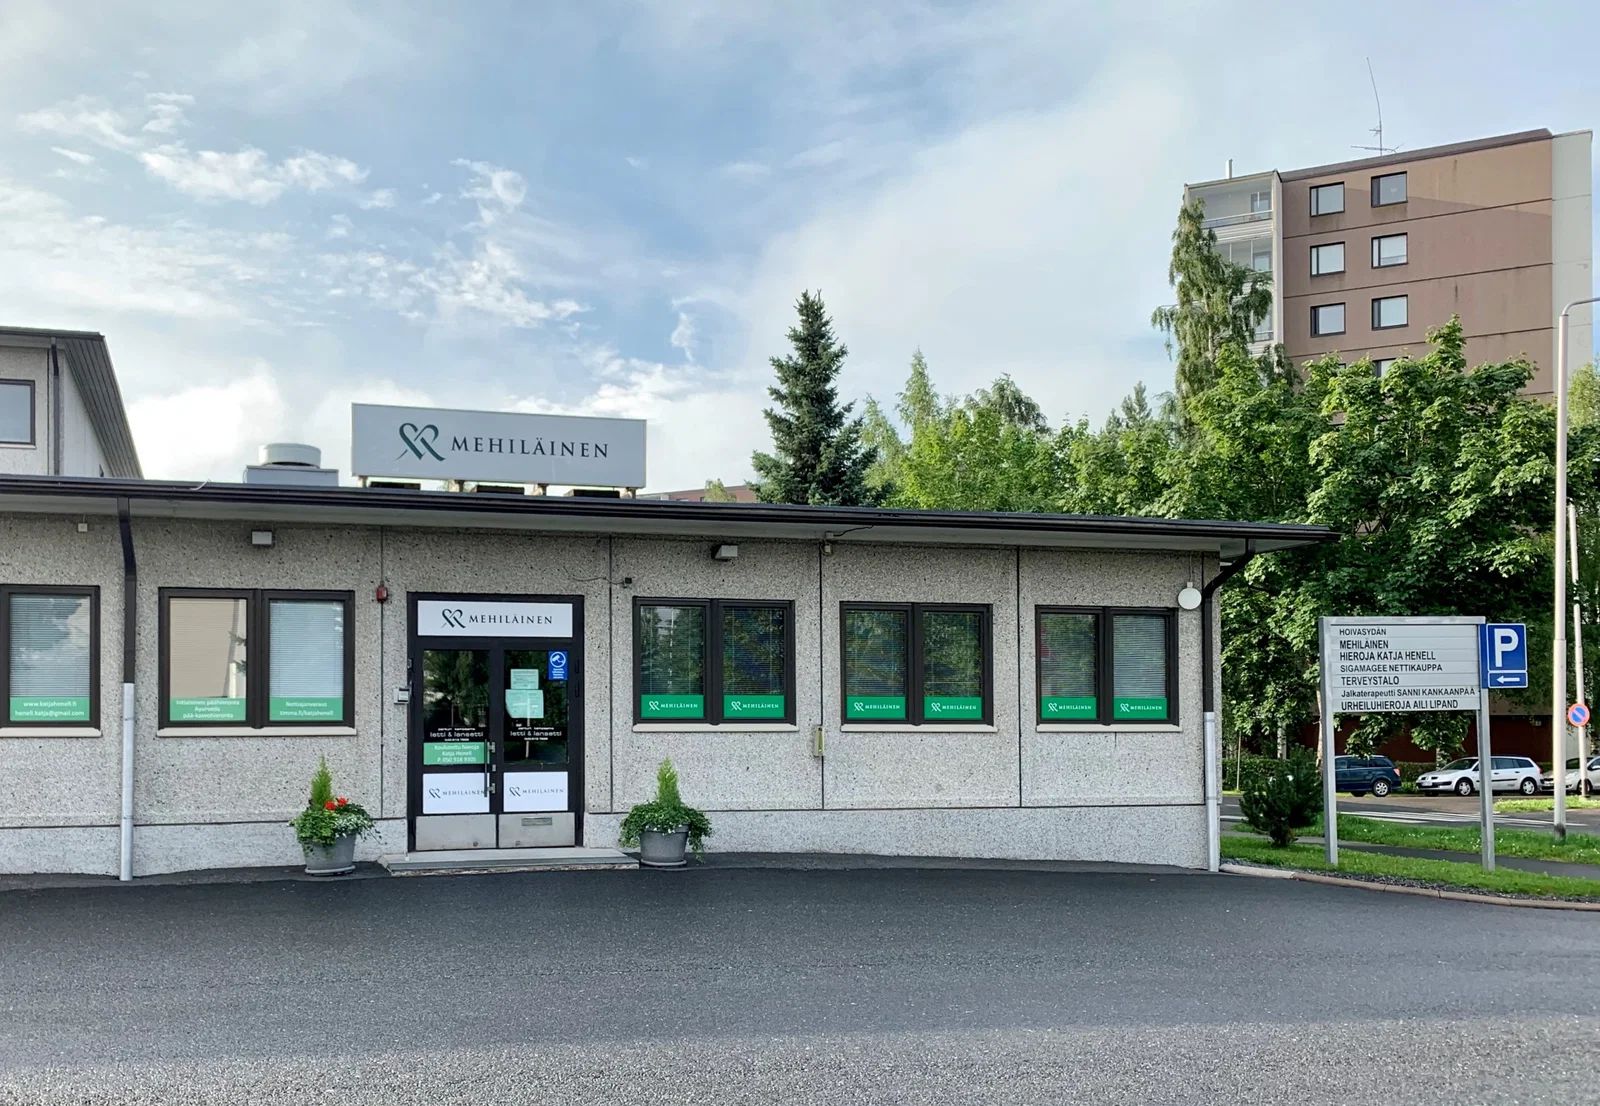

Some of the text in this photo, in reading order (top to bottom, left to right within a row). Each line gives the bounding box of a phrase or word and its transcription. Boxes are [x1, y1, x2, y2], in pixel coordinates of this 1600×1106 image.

[451, 435, 609, 458] MEHILÄINEN
[468, 613, 553, 625] MEHILÄINEN
[1339, 627, 1387, 636] HOIVASYDÄN
[1339, 638, 1389, 649] MEHILÄINEN
[1494, 628, 1519, 667] P
[1339, 651, 1436, 661] HIEROJA KATJA HENELL
[1340, 664, 1443, 673] SIGAMAGEE NETTIKAUPPA
[1341, 676, 1400, 686] TERVEYSTALO
[1341, 686, 1476, 698] Jalkaterapeutti SANNI KANKAANPÄÄ
[1341, 699, 1459, 711] URHEILUHIEROJA AILI LIPAND
